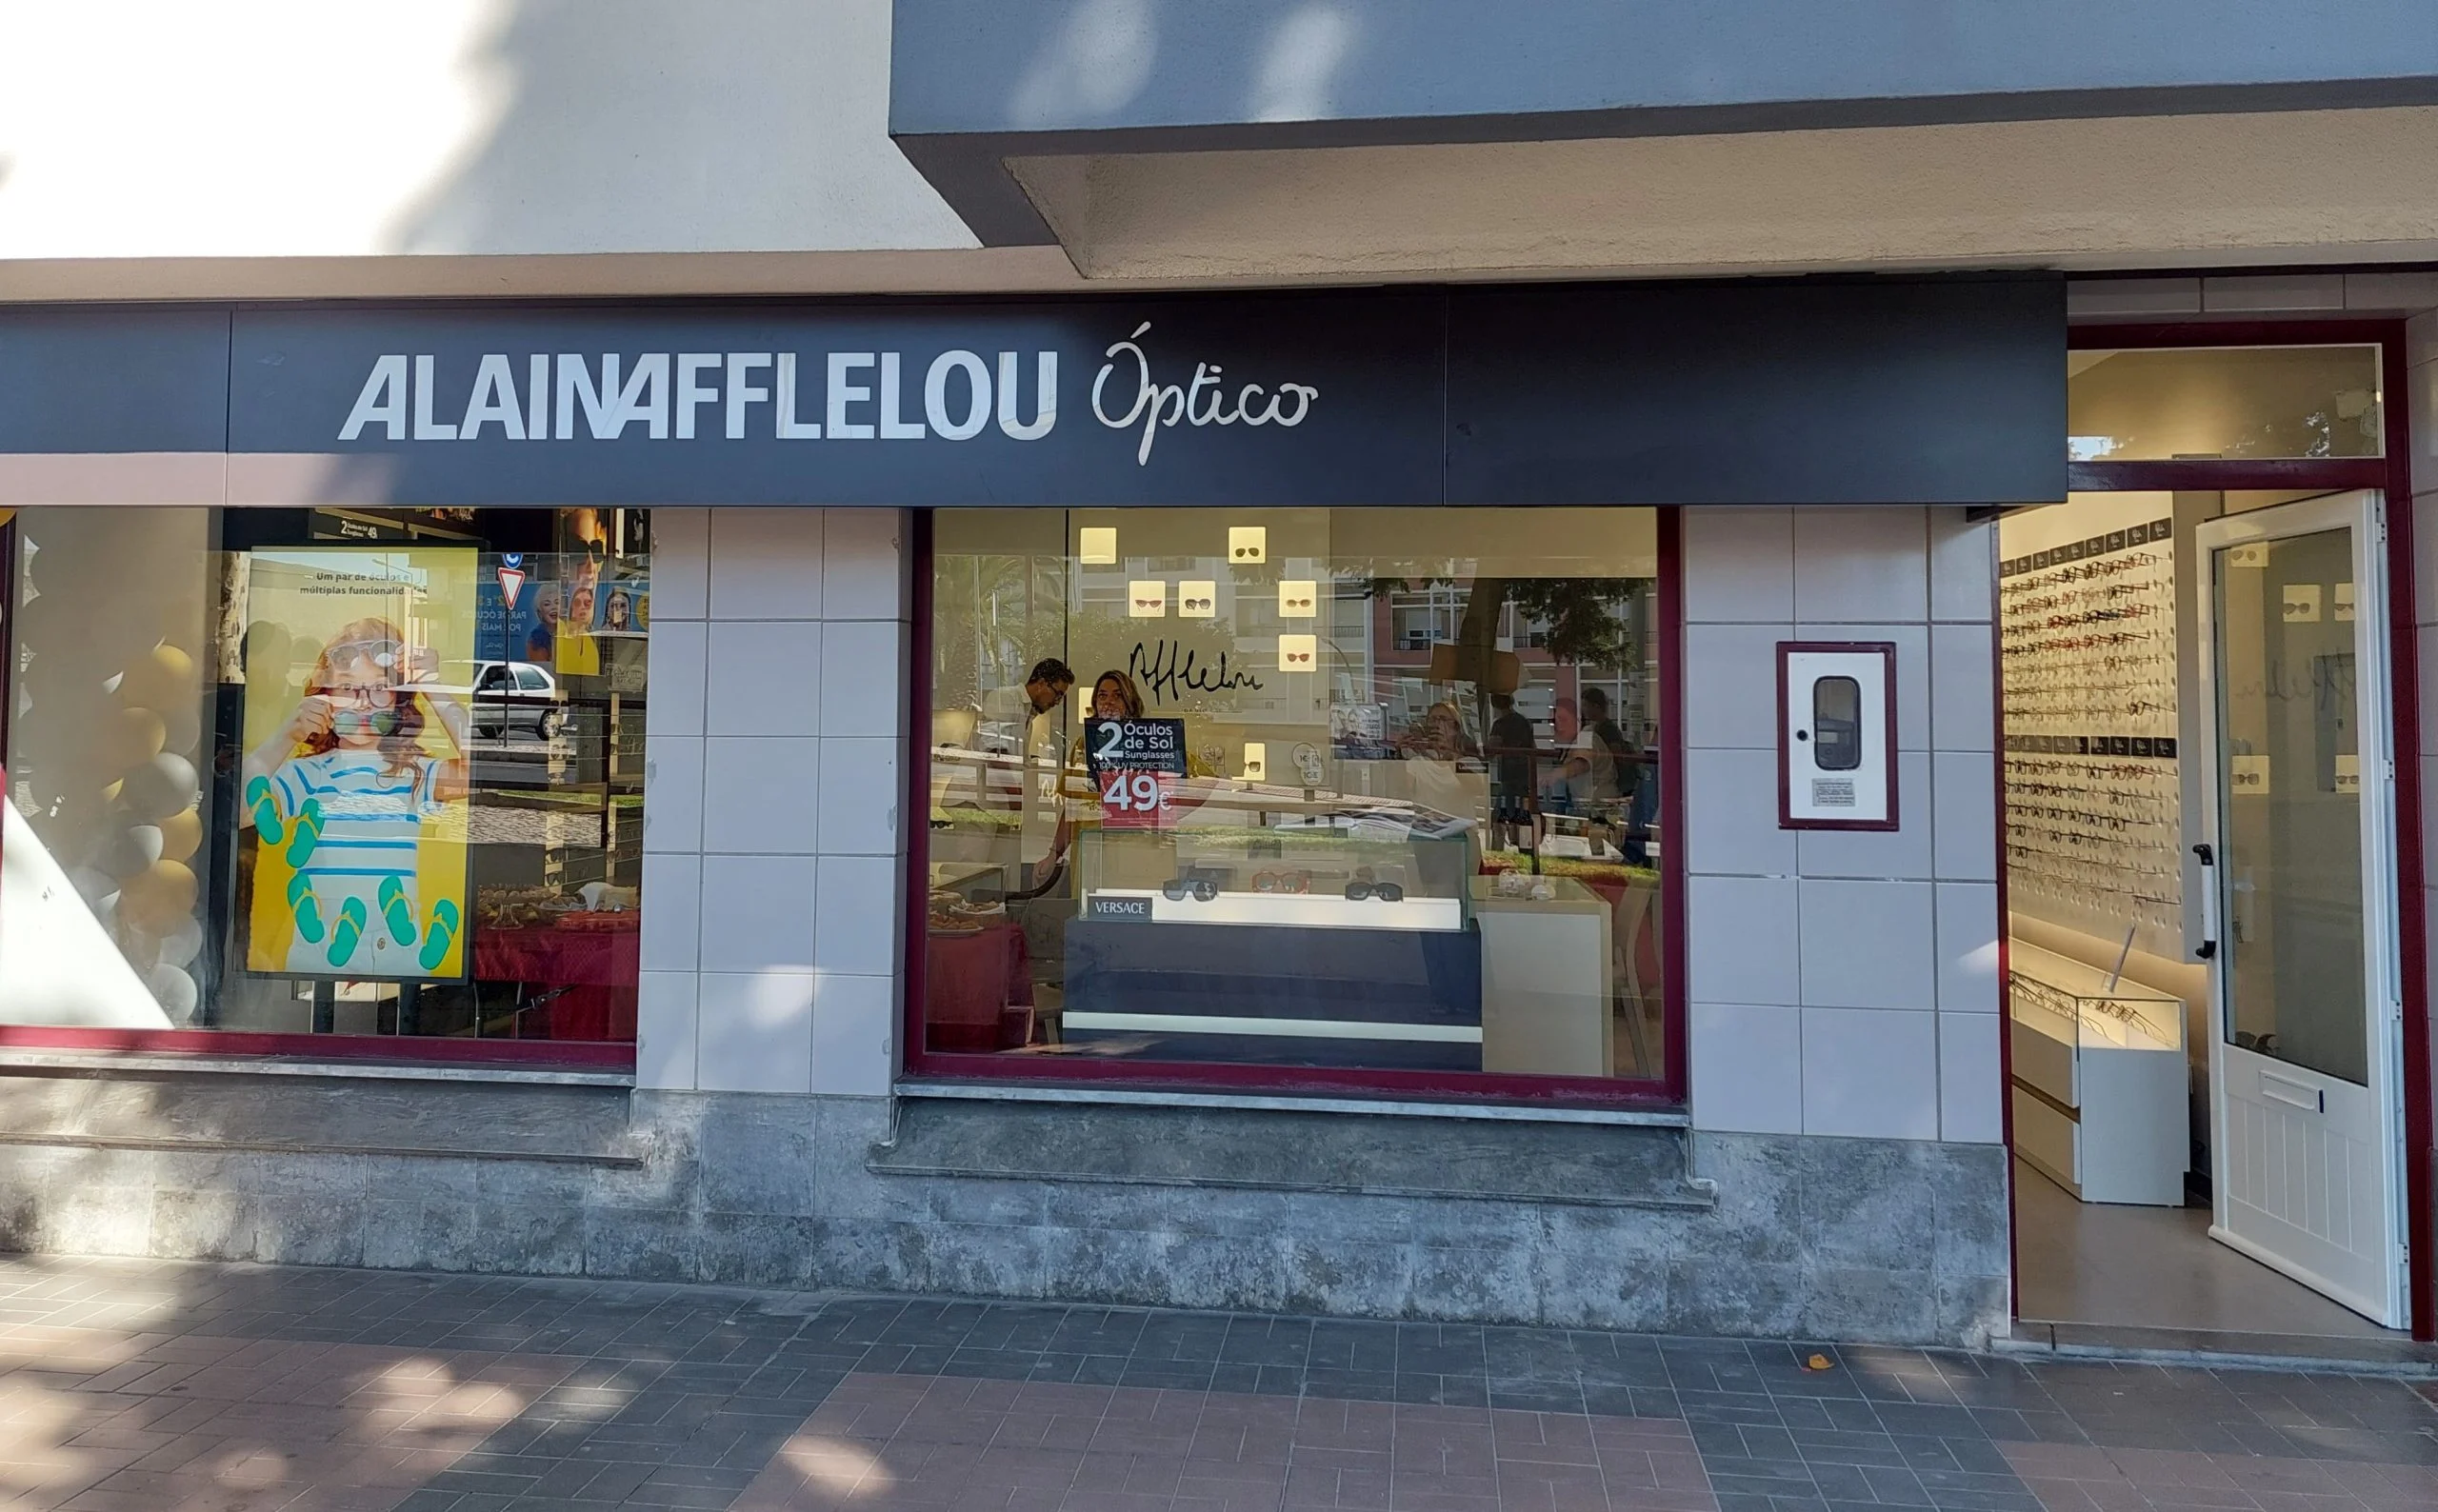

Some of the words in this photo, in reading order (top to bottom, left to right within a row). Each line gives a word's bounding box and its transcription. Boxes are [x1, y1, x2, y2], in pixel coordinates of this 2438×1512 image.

[1090, 320, 1320, 466] Óptico
[340, 520, 348, 534] 2
[316, 572, 333, 581] Um
[335, 573, 352, 583] par
[354, 571, 367, 581] de
[300, 586, 347, 596] múltiplas
[1097, 721, 1124, 758] 2
[1124, 719, 1173, 736] Óculos
[1124, 736, 1145, 749] de
[1149, 736, 1174, 749] Sol
[1124, 750, 1175, 761] Sunglasses
[1094, 900, 1146, 915] VERSACE
